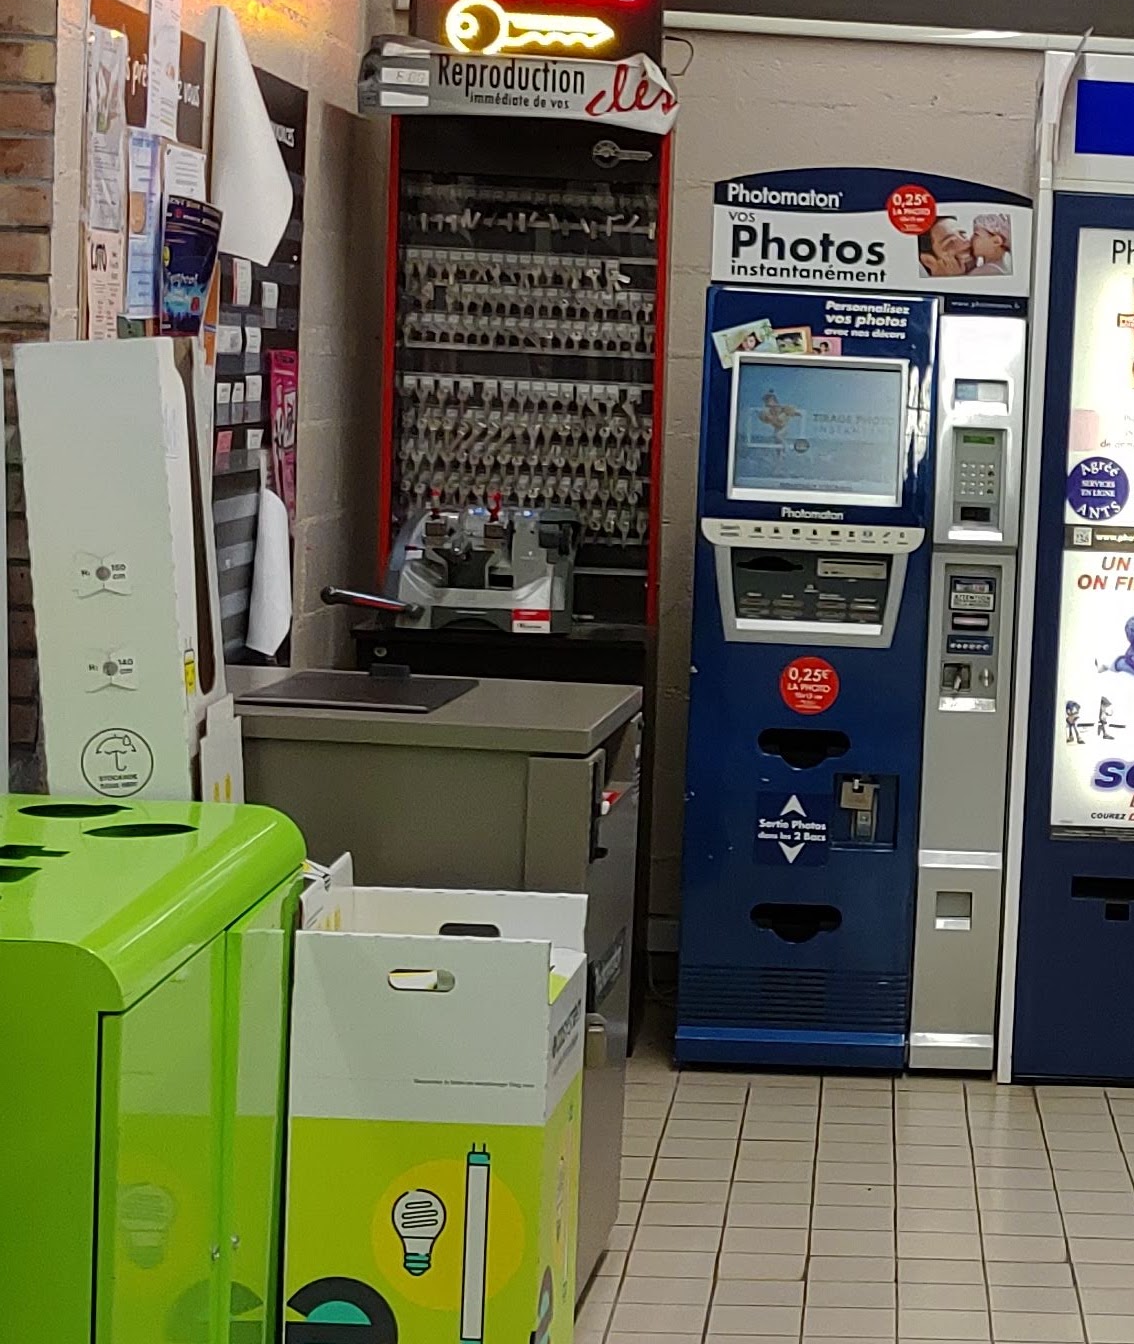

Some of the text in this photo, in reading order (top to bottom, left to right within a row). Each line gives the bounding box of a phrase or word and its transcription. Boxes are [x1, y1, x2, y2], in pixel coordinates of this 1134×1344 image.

[439, 54, 585, 97] Reproduction
[585, 64, 680, 116] clés
[470, 92, 570, 109] immédiate de vos
[727, 184, 841, 208] Photomaton
[892, 193, 929, 208] 0,25€
[730, 223, 886, 265] Photos
[730, 260, 886, 283] instantanément
[825, 301, 910, 315] Personnalisez
[825, 314, 908, 328] vos photos
[1080, 461, 1121, 477] Agréé
[781, 506, 844, 520] Photomaton
[1077, 501, 1121, 519] ANTS
[1102, 556, 1131, 572] UN
[1077, 574, 1108, 591] ON
[788, 667, 830, 683] 0,25€
[787, 683, 798, 691] LA
[758, 818, 827, 830] Sortie Photos
[1090, 812, 1127, 821] COUREZ
[794, 832, 801, 841] 2
[803, 832, 826, 841] Bacs
